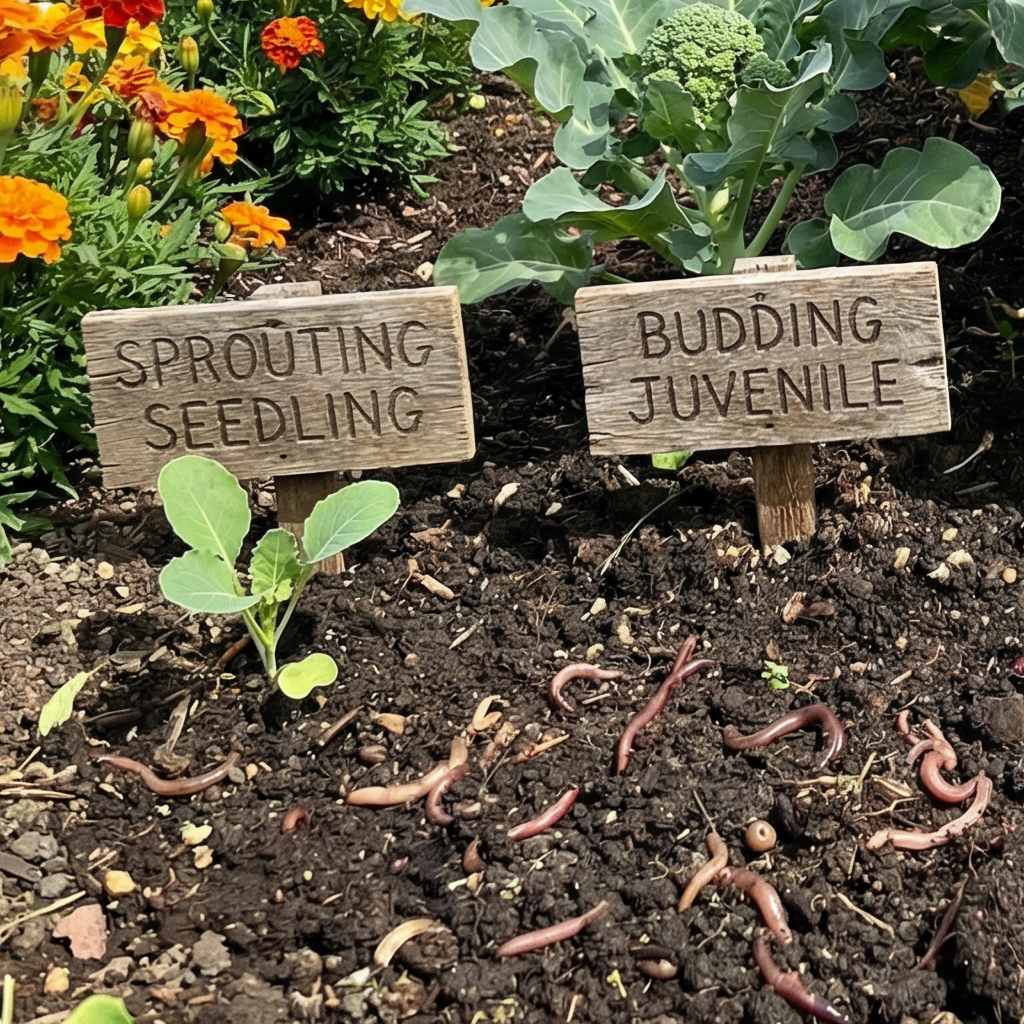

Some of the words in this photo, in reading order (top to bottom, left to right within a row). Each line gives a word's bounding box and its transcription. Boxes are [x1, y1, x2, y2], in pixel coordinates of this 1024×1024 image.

[115, 320, 434, 389] SPROUTING
[637, 296, 883, 359] BUDDING
[144, 386, 424, 450] SEEDLING
[628, 358, 904, 425] JUVENILE
